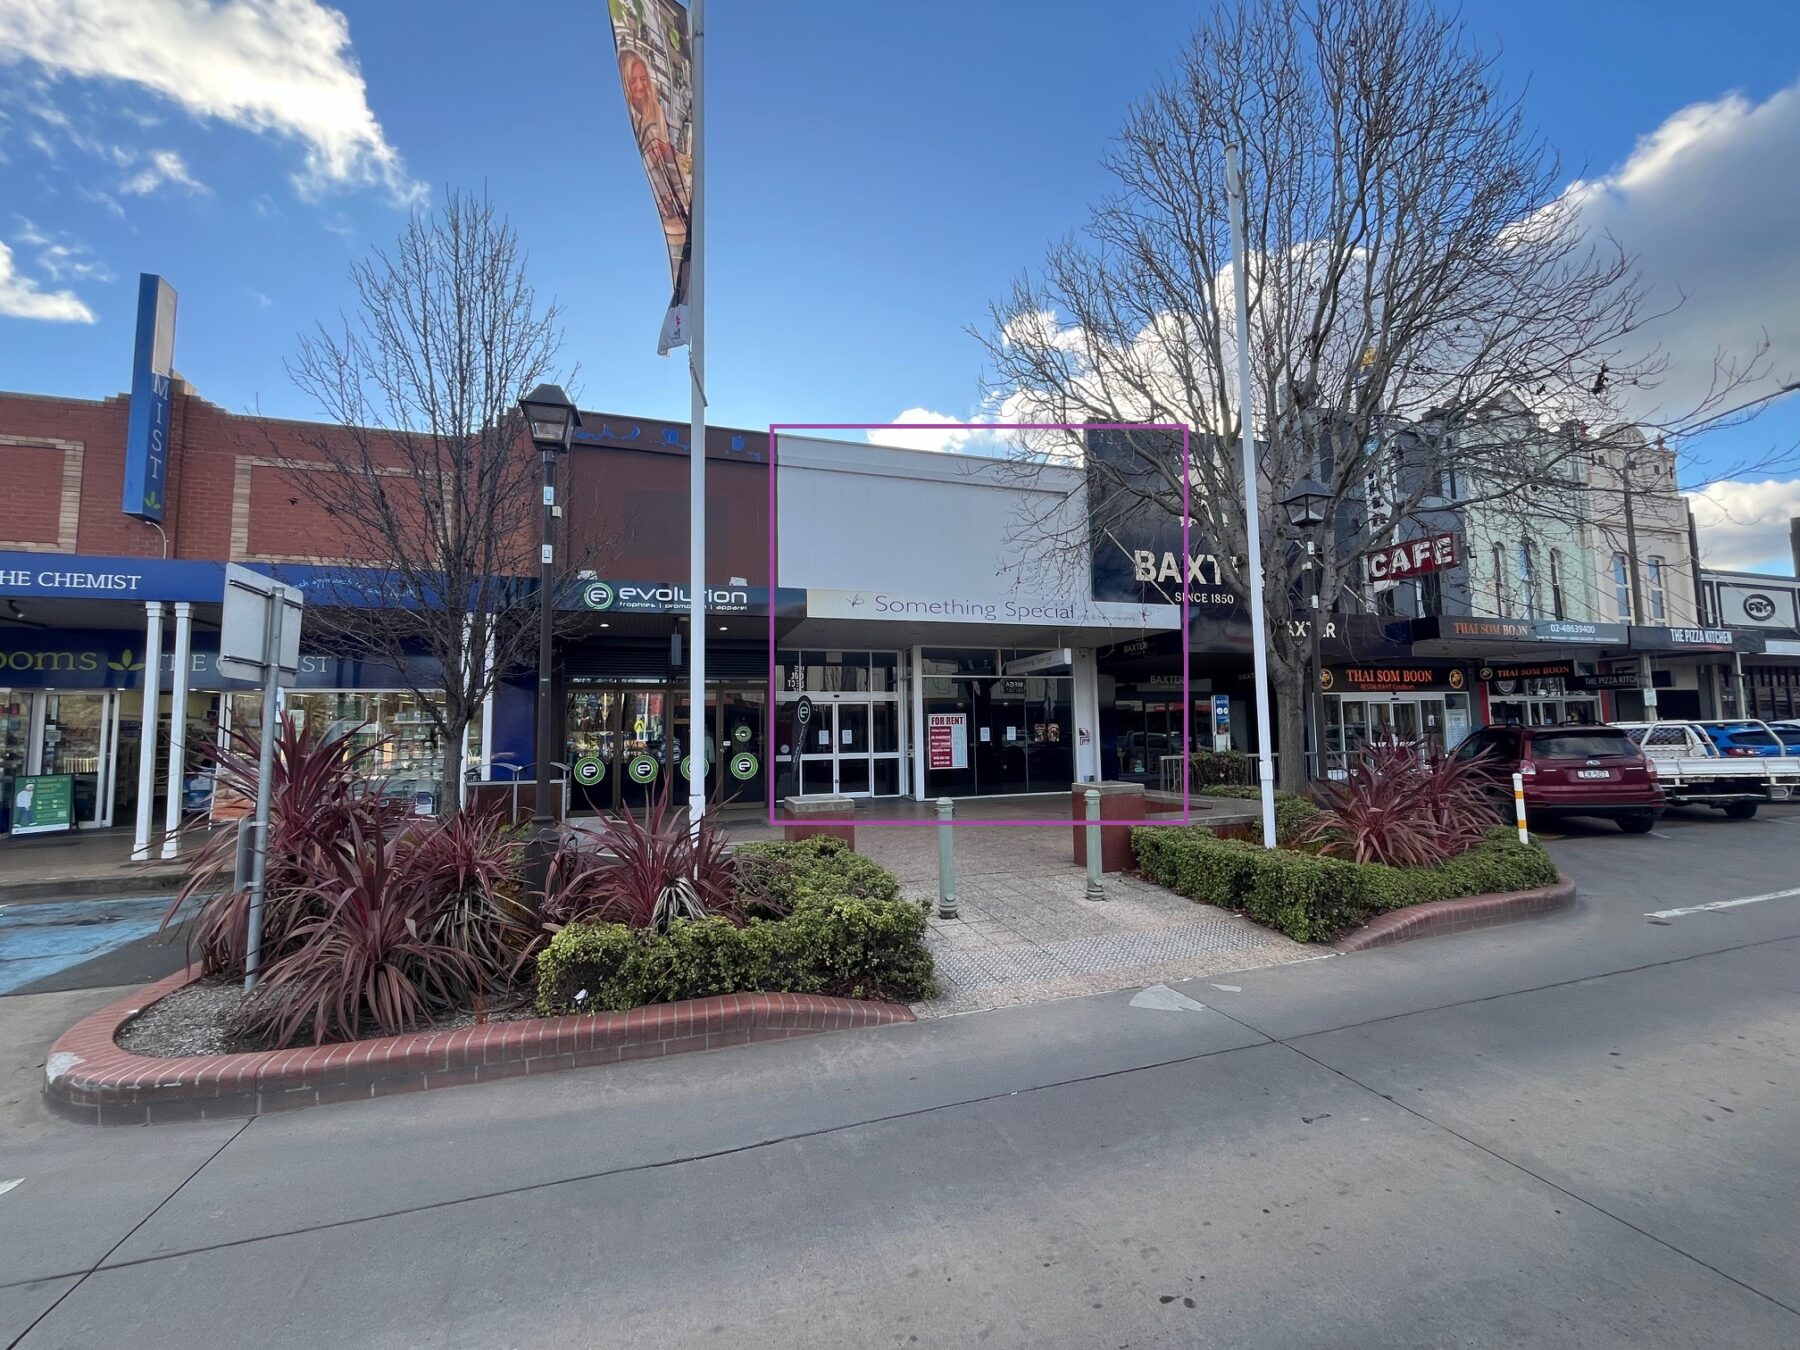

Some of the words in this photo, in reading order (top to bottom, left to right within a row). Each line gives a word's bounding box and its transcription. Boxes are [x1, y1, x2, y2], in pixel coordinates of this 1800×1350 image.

[1369, 537, 1453, 578] CAFE
[1135, 550, 1240, 586] BAXT
[38, 571, 142, 590] CHEMIST
[619, 586, 748, 604] evoluion
[1175, 592, 1208, 603] SINCE
[1211, 593, 1235, 604] 1850
[875, 595, 997, 621] Something
[1005, 601, 1074, 621] Special
[1453, 622, 1479, 635] THAI
[1481, 623, 1500, 636] SOM
[1502, 624, 1528, 636] BOON
[1550, 623, 1596, 634] 02-48639400
[1670, 628, 1684, 642] THE
[1685, 629, 1704, 643] PIZZA
[1705, 630, 1733, 644] KITCHEN
[0, 651, 98, 671] oms
[1346, 669, 1374, 682] THAI
[1377, 669, 1401, 682] SOM
[1403, 670, 1433, 682] BOON
[1497, 670, 1518, 678] THAI
[1521, 668, 1540, 676] SOM
[1543, 665, 1569, 675] BOON
[931, 716, 945, 726] FOR
[946, 716, 964, 725] RENT
